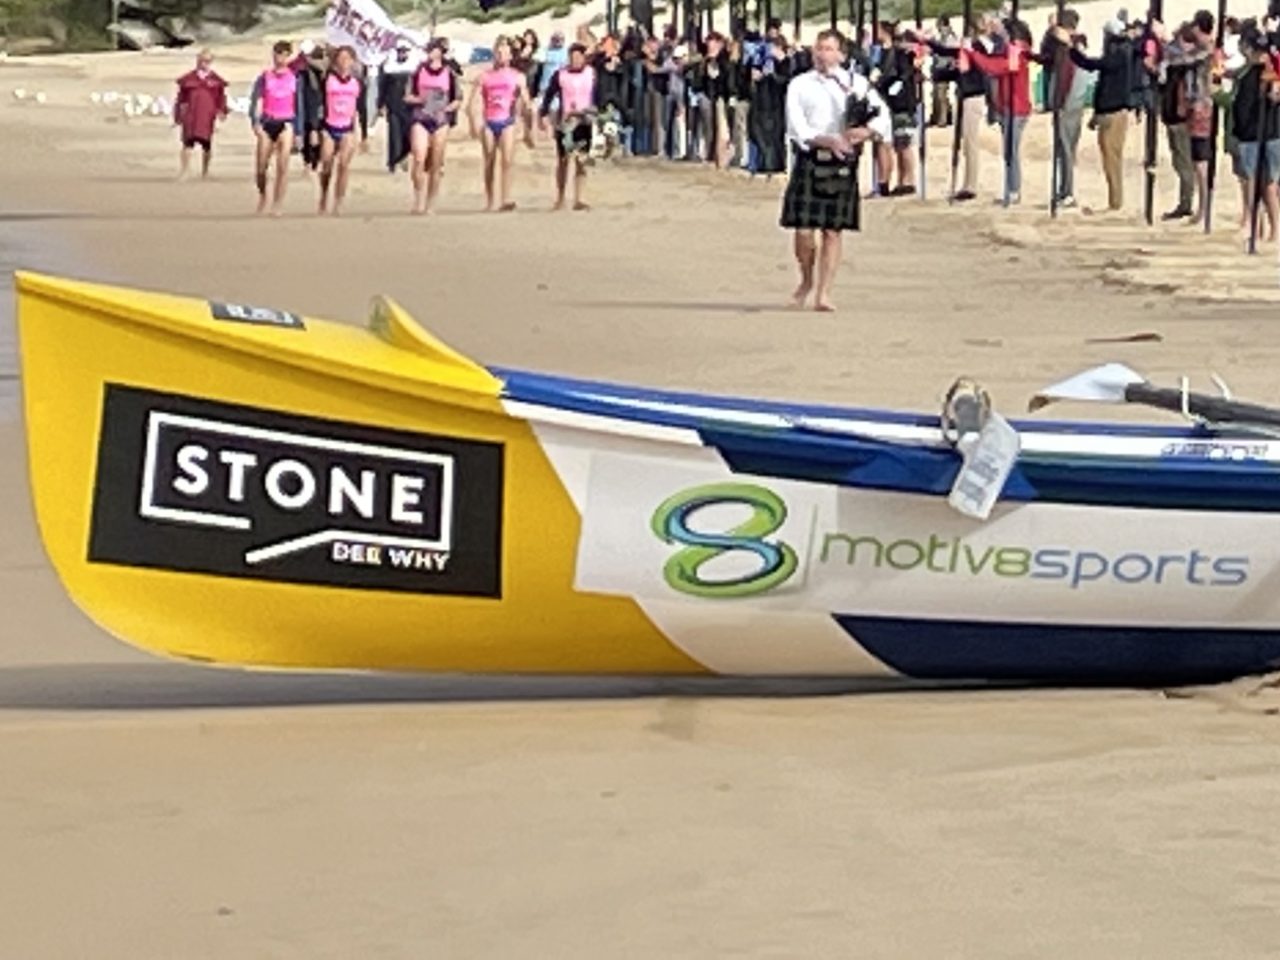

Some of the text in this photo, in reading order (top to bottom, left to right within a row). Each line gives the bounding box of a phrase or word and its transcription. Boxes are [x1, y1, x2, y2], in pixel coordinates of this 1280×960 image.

[172, 444, 426, 524] STONE
[332, 541, 450, 571] DEE WHY
[819, 530, 1250, 589] motiv8sports
